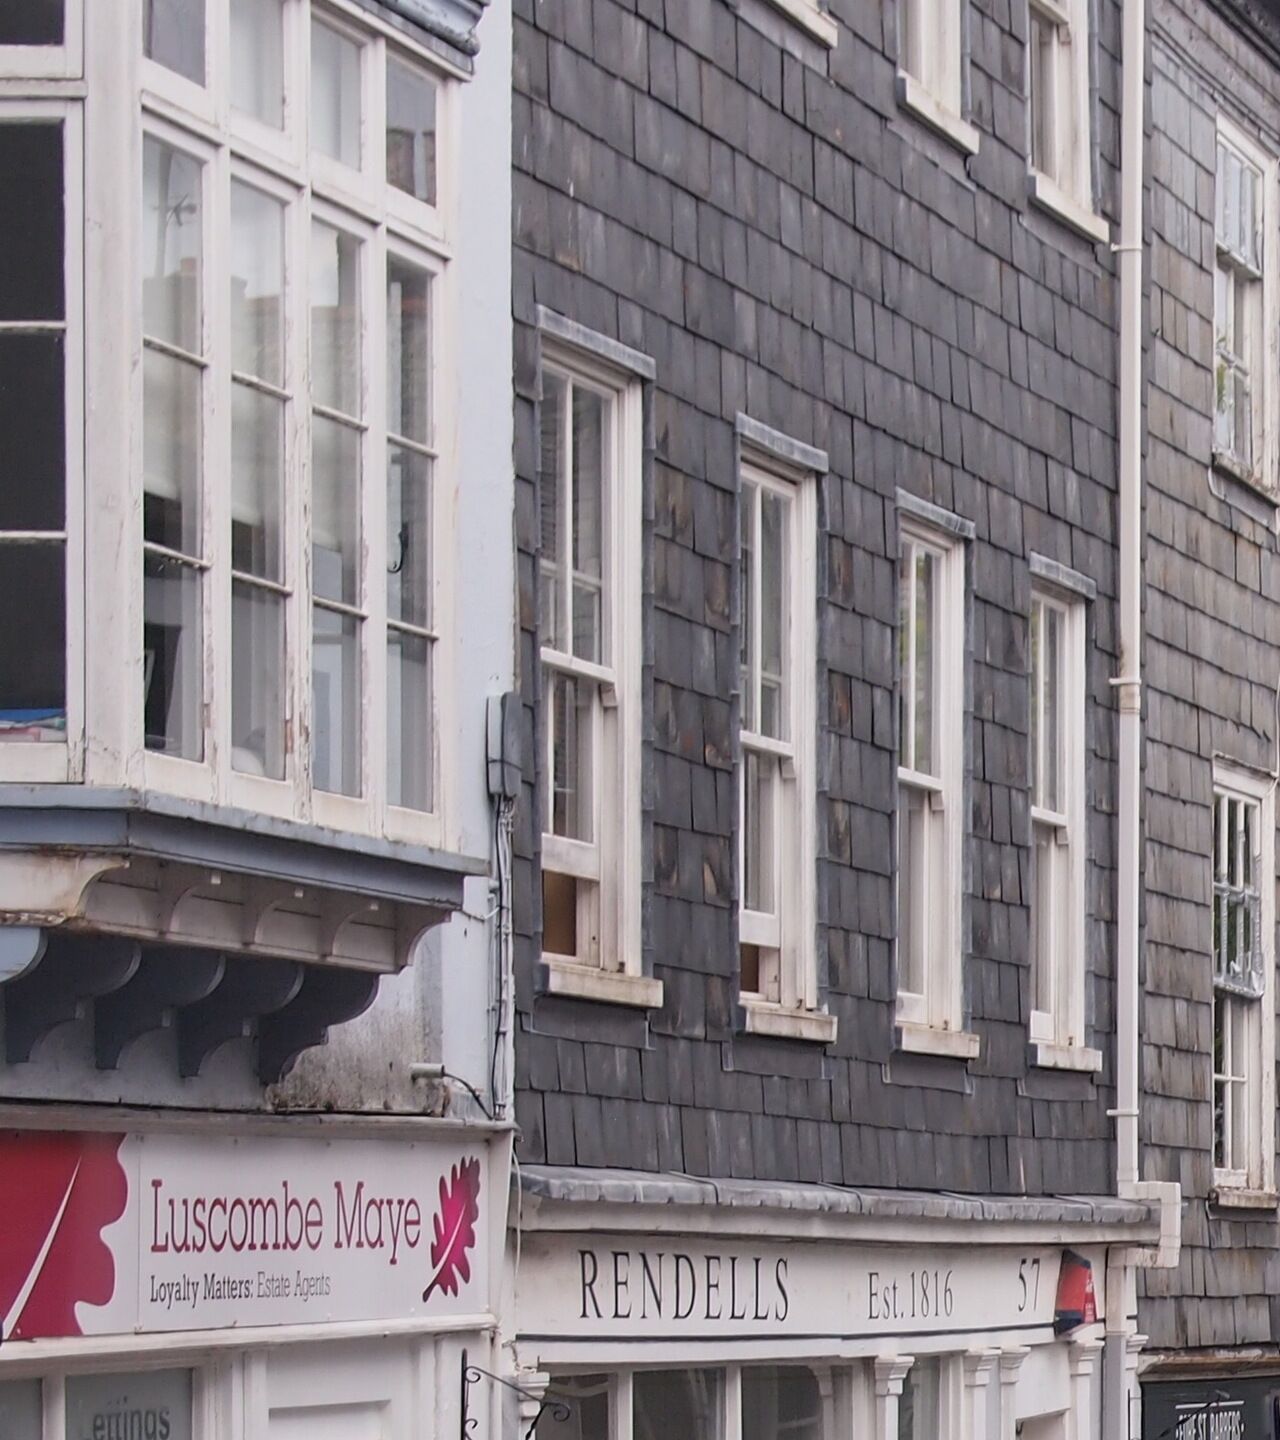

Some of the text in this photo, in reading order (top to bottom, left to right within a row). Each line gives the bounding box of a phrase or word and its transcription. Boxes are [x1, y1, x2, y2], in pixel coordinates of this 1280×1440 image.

[151, 1180, 420, 1264] Luscombe Maye
[150, 1270, 330, 1309] Loyalty Matters: Estate Agents
[579, 1250, 789, 1321] RENDELLS
[1018, 1258, 1040, 1312] 57
